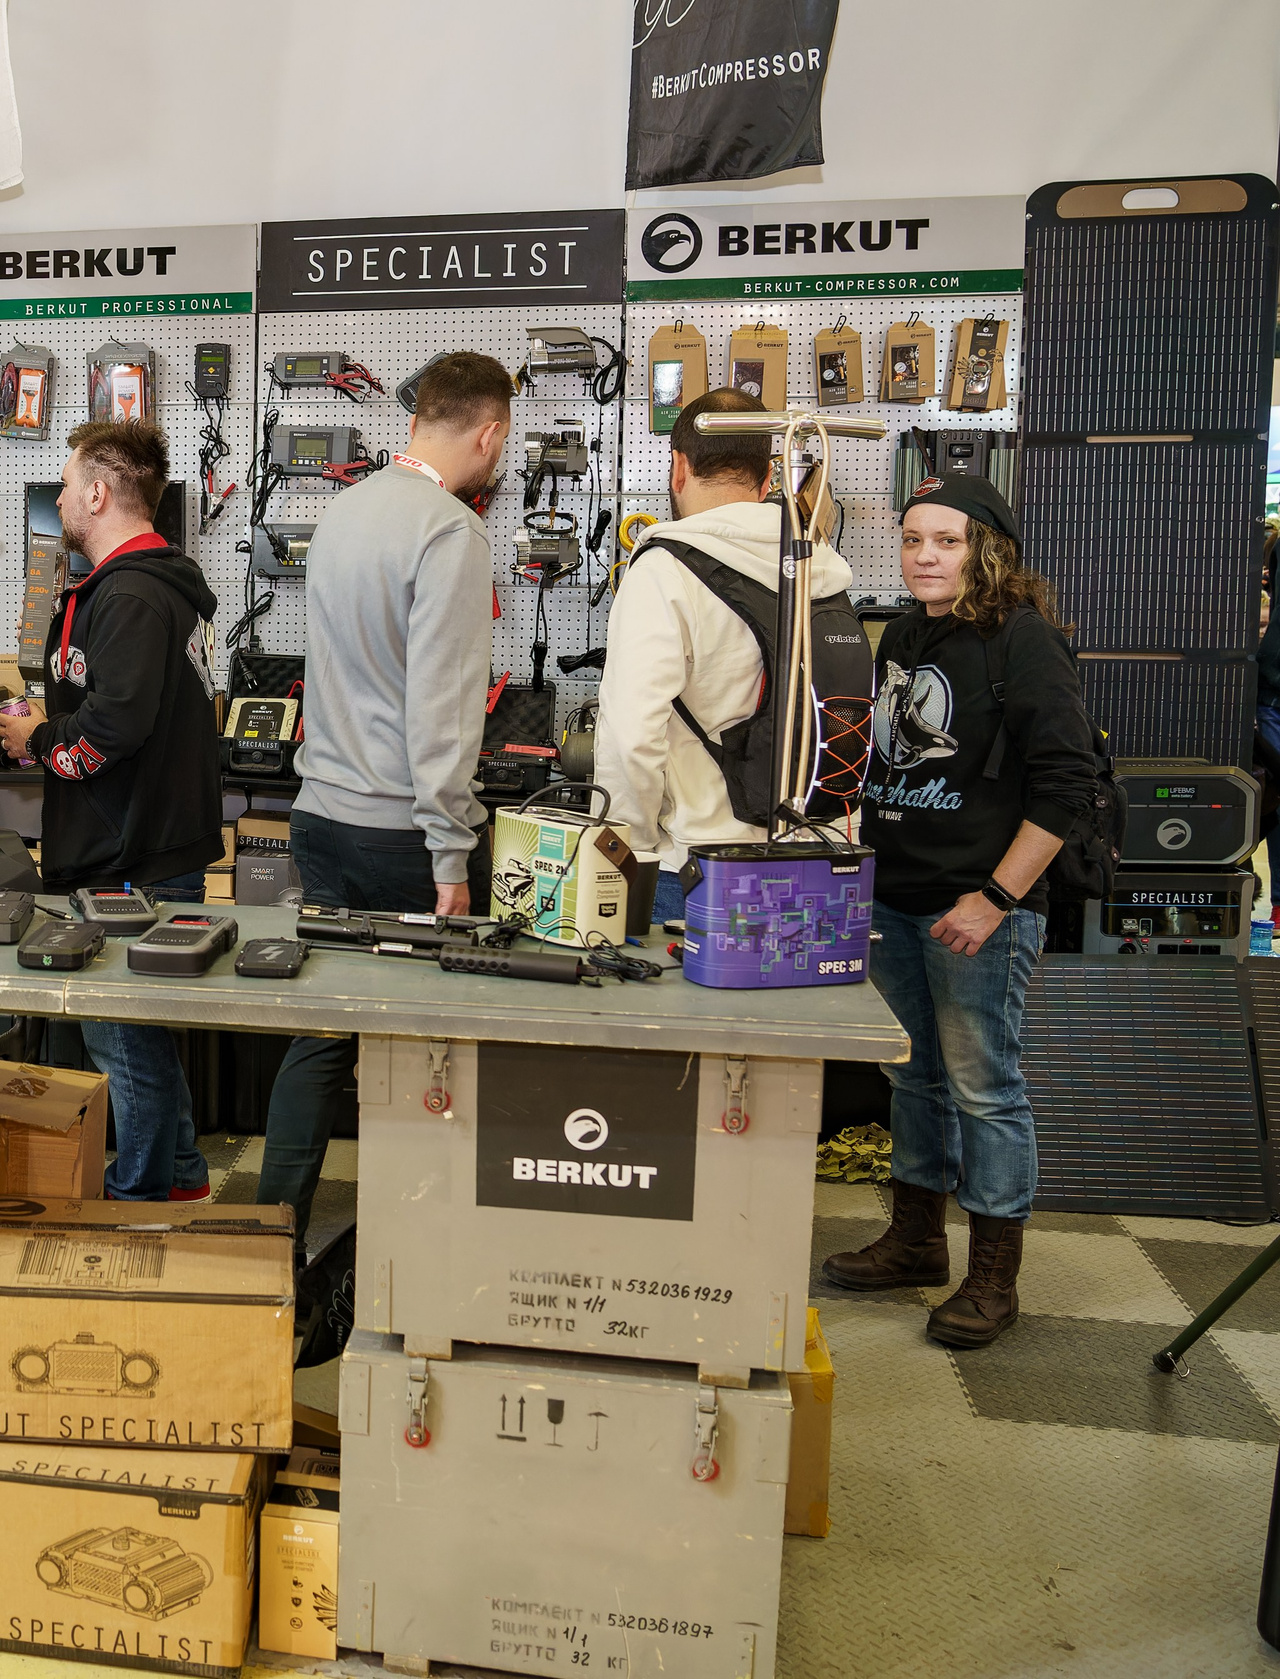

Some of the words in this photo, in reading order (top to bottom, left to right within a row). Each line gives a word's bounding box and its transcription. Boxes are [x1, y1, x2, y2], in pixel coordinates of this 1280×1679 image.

[718, 218, 930, 257] BERKUT
[307, 241, 577, 283] SPECIALIST
[744, 276, 960, 293] BERKUT-COMPRESSOR.COM
[25, 303, 88, 315] BERKUT
[102, 297, 233, 313] PROFESSIONAL
[825, 634, 862, 643] cyclotech
[891, 709, 901, 741] KAMCHATKA
[238, 741, 278, 749] SPECIALIST
[885, 810, 903, 821] WAVE
[239, 835, 290, 850] SPECIALI
[541, 834, 563, 844] BERKUT
[250, 867, 275, 875] SMART
[534, 860, 554, 873] SPEC
[832, 866, 860, 874] BERKUT
[250, 873, 275, 881] POWER
[597, 873, 622, 881] BERKUT
[1132, 893, 1214, 904] SPECIALIST
[818, 960, 847, 975] SPEC
[848, 959, 863, 973] 3M
[512, 1157, 657, 1189] BERKUT
[509, 1269, 604, 1291] КОМПЛЕКТ
[626, 1279, 733, 1305] 5320361929
[509, 1291, 557, 1309] ЯЩИК
[584, 1297, 606, 1313] 1/1
[508, 1313, 575, 1333] БРУТТО
[59, 1415, 265, 1447] SPECIALIST
[12, 1459, 220, 1493] SPECIALIST
[161, 1506, 198, 1517] BERKUT
[491, 1598, 583, 1622] КОМПЛЕКТ
[607, 1613, 714, 1639] 5320361897
[9, 1618, 213, 1664] SPECIALIST
[491, 1619, 539, 1638] ЯЩИК
[563, 1626, 588, 1648] 1/1
[490, 1640, 556, 1661] БРУТТО
[570, 1651, 590, 1667] 32
[607, 1655, 628, 1669] КГ
